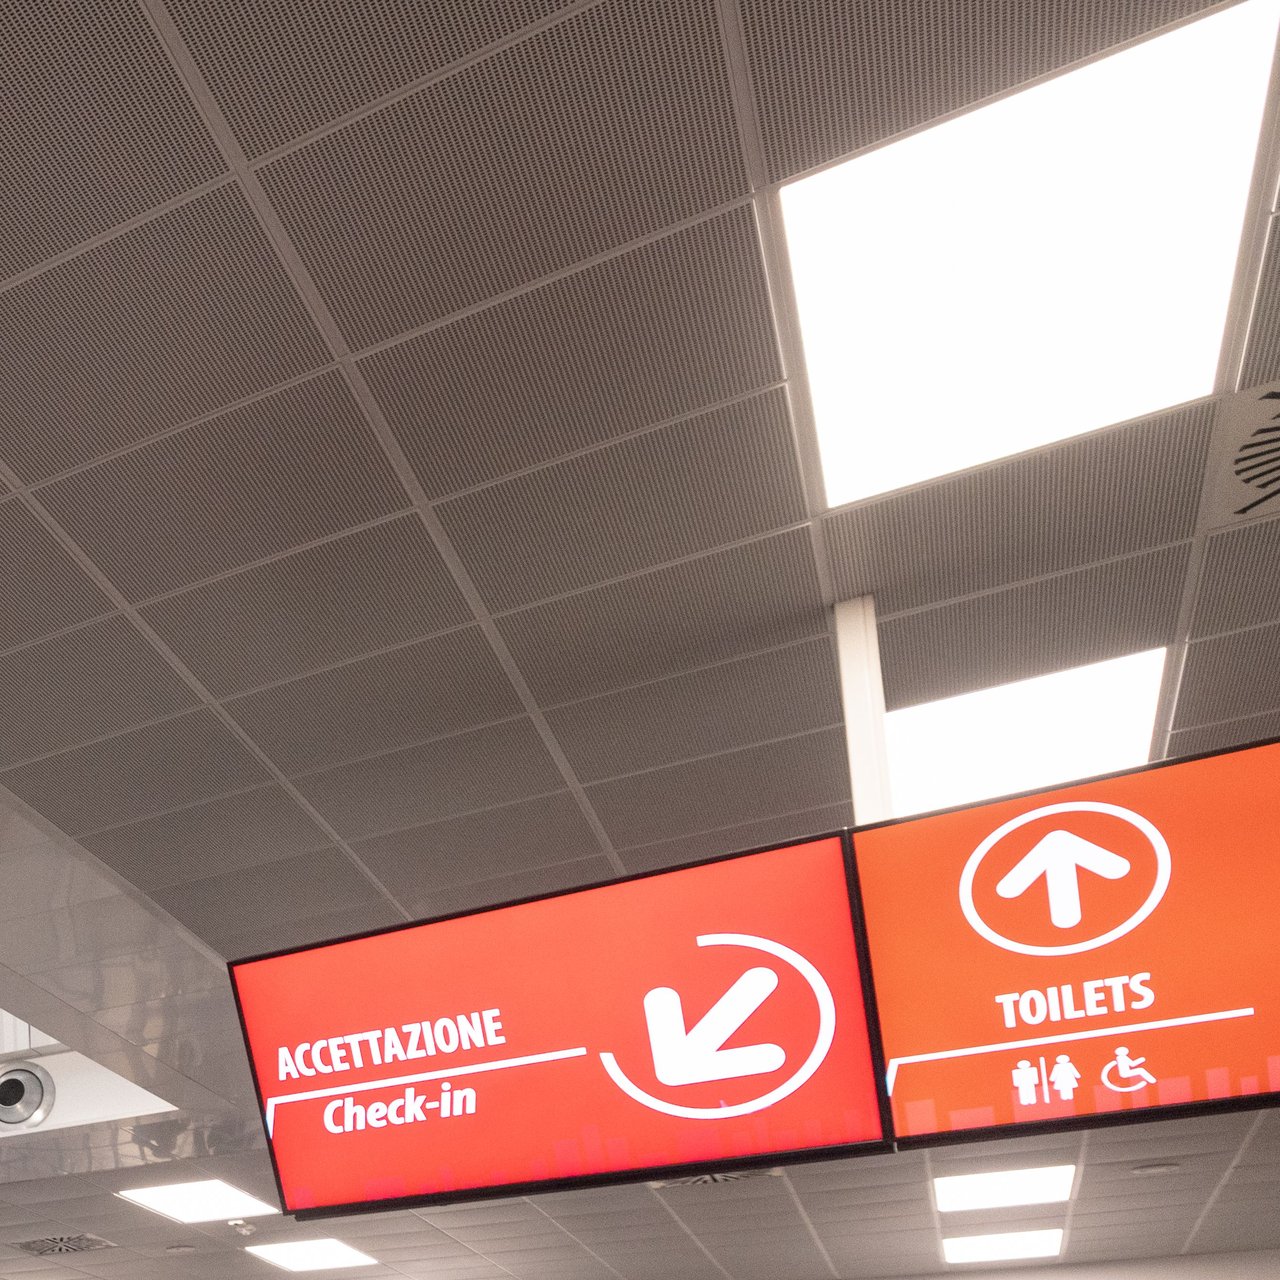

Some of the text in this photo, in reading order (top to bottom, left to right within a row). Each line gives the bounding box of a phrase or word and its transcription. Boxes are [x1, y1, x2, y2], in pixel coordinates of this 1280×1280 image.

[995, 973, 1155, 1029] TOILETS
[278, 1010, 506, 1081] ACCETTAZIONE
[323, 1083, 477, 1135] Check-in
